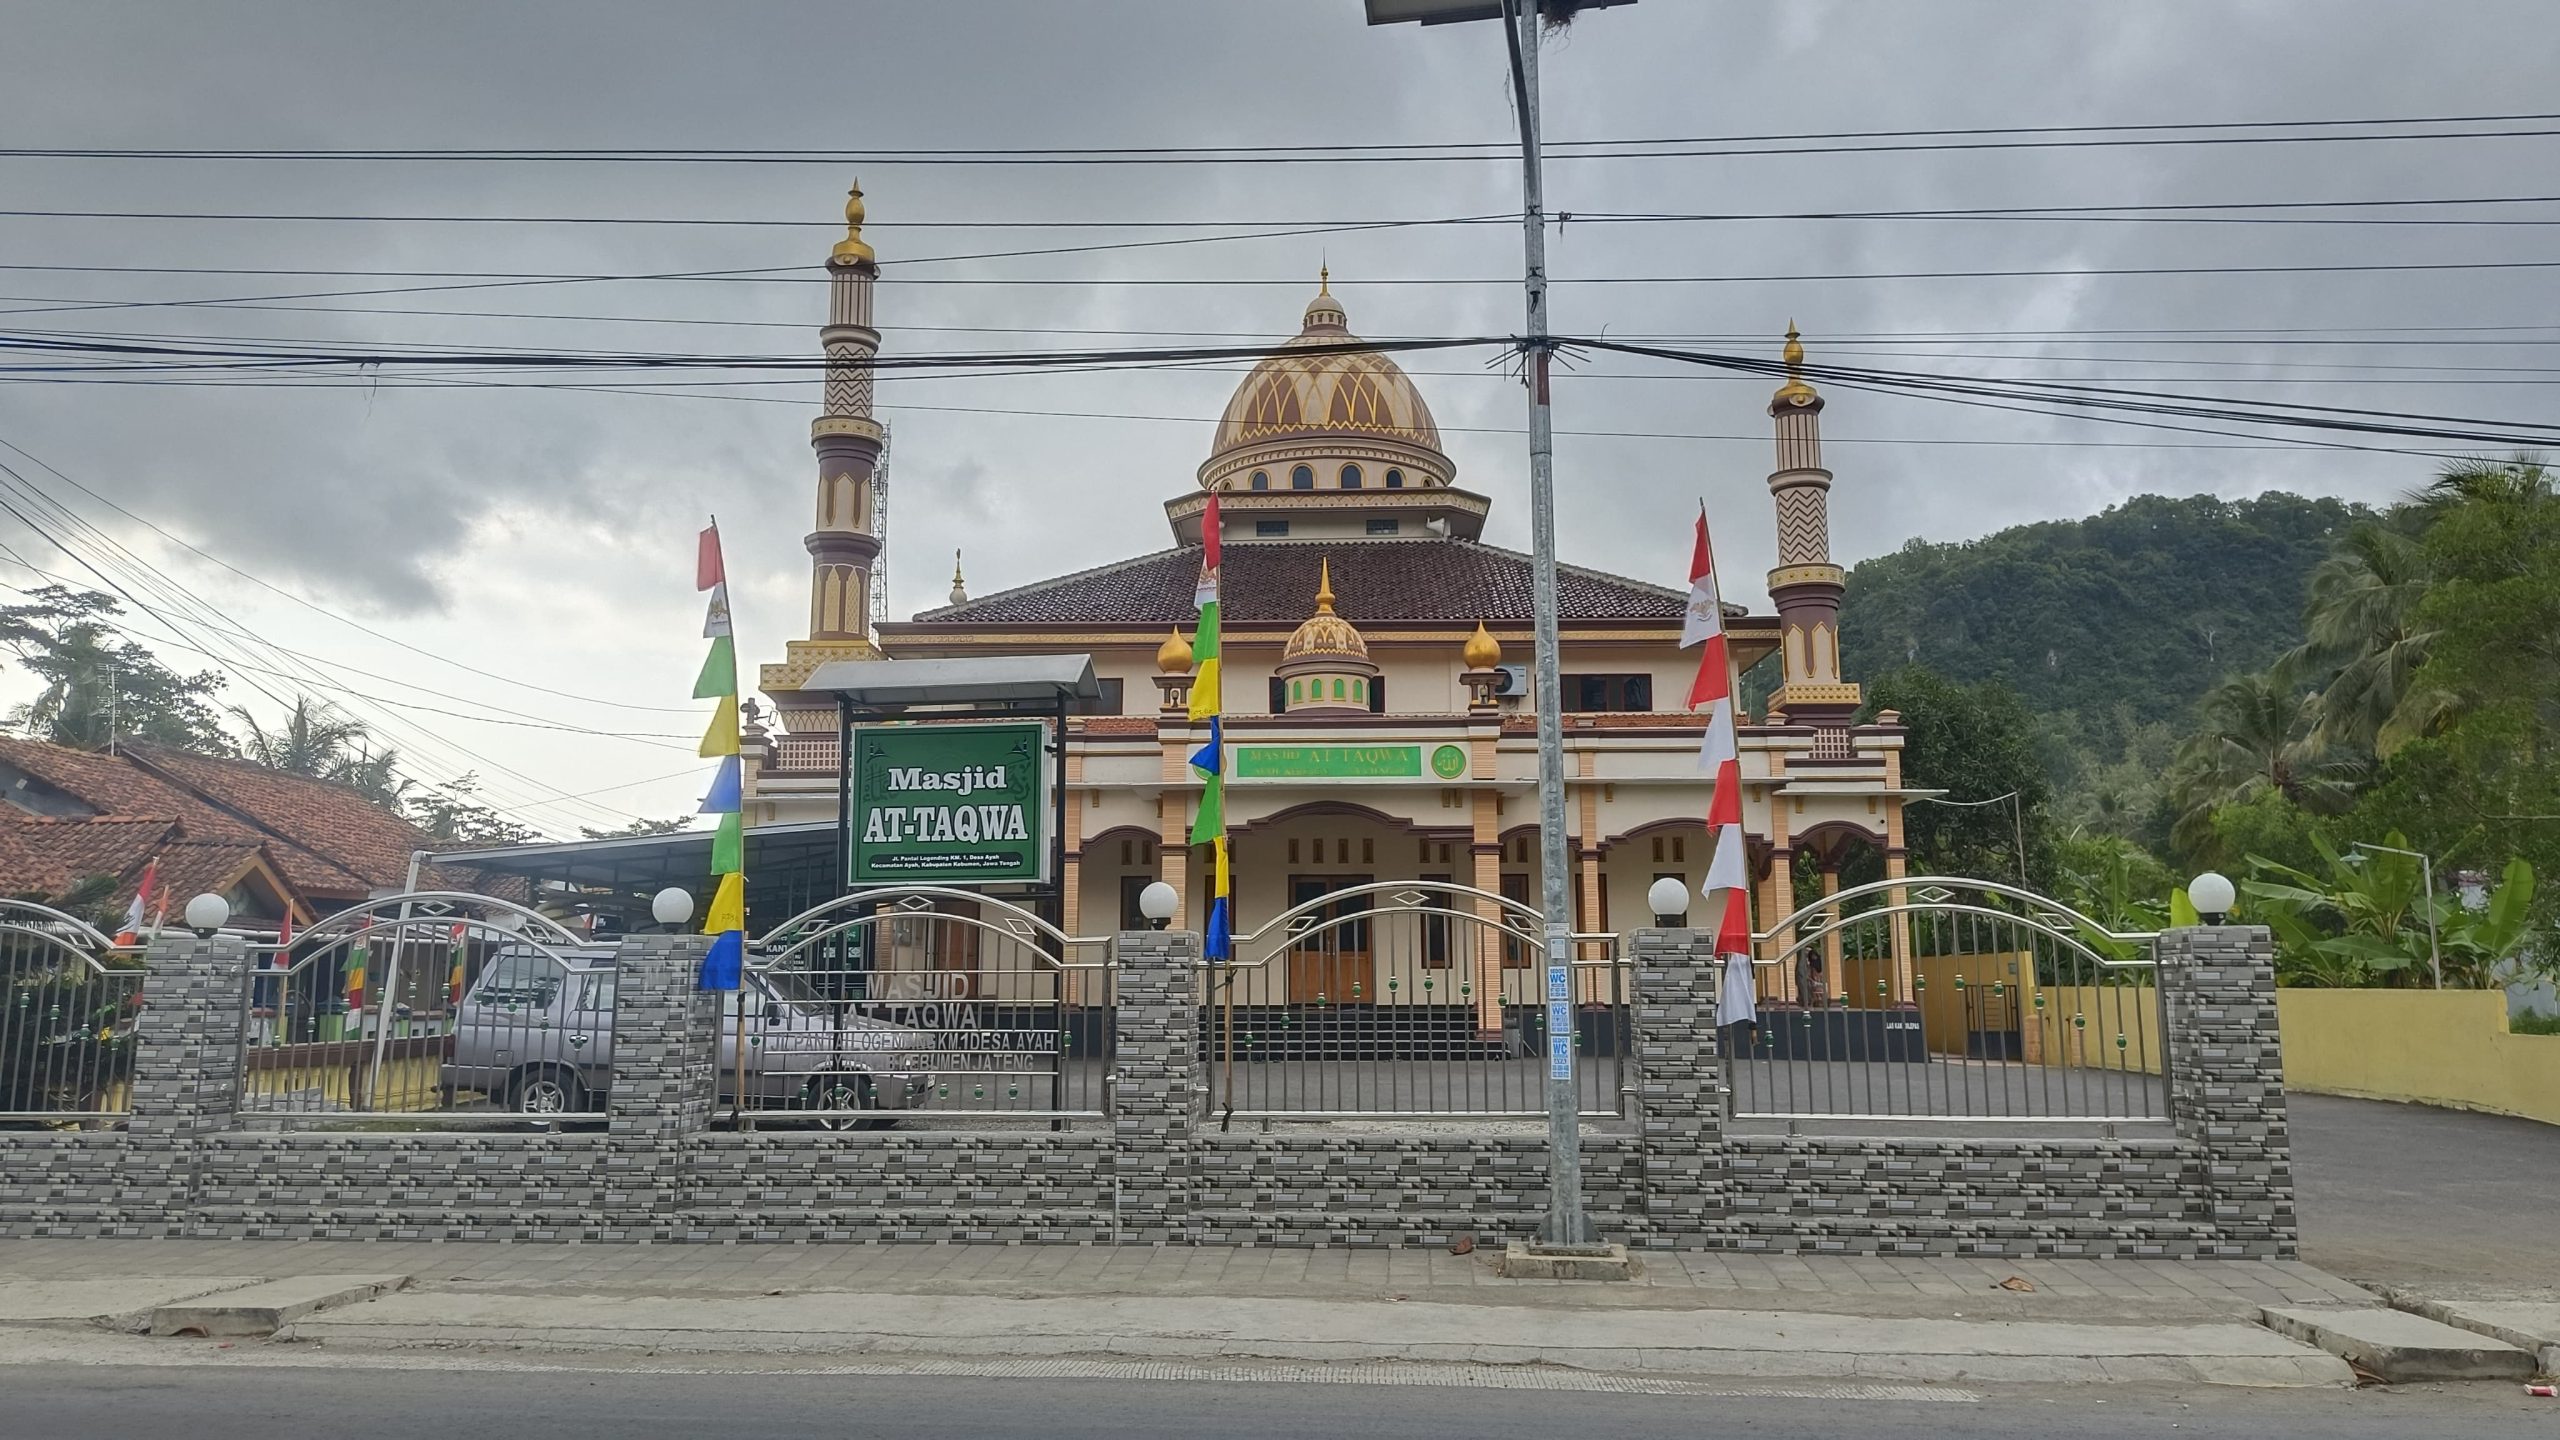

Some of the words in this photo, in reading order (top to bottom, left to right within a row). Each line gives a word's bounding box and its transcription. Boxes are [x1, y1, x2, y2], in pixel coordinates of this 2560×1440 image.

[887, 765, 1007, 795] Masjid
[863, 804, 1029, 844] AT-TAQWA
[865, 973, 969, 1000] MASJID
[1550, 974, 1566, 983] WC
[845, 1003, 879, 1029] AT
[885, 1003, 978, 1029] TAQWA
[1552, 1007, 1567, 1015] WC
[1016, 1032, 1054, 1050] AYAH
[1553, 1043, 1567, 1054] WC
[972, 1053, 1034, 1071] JATENG
